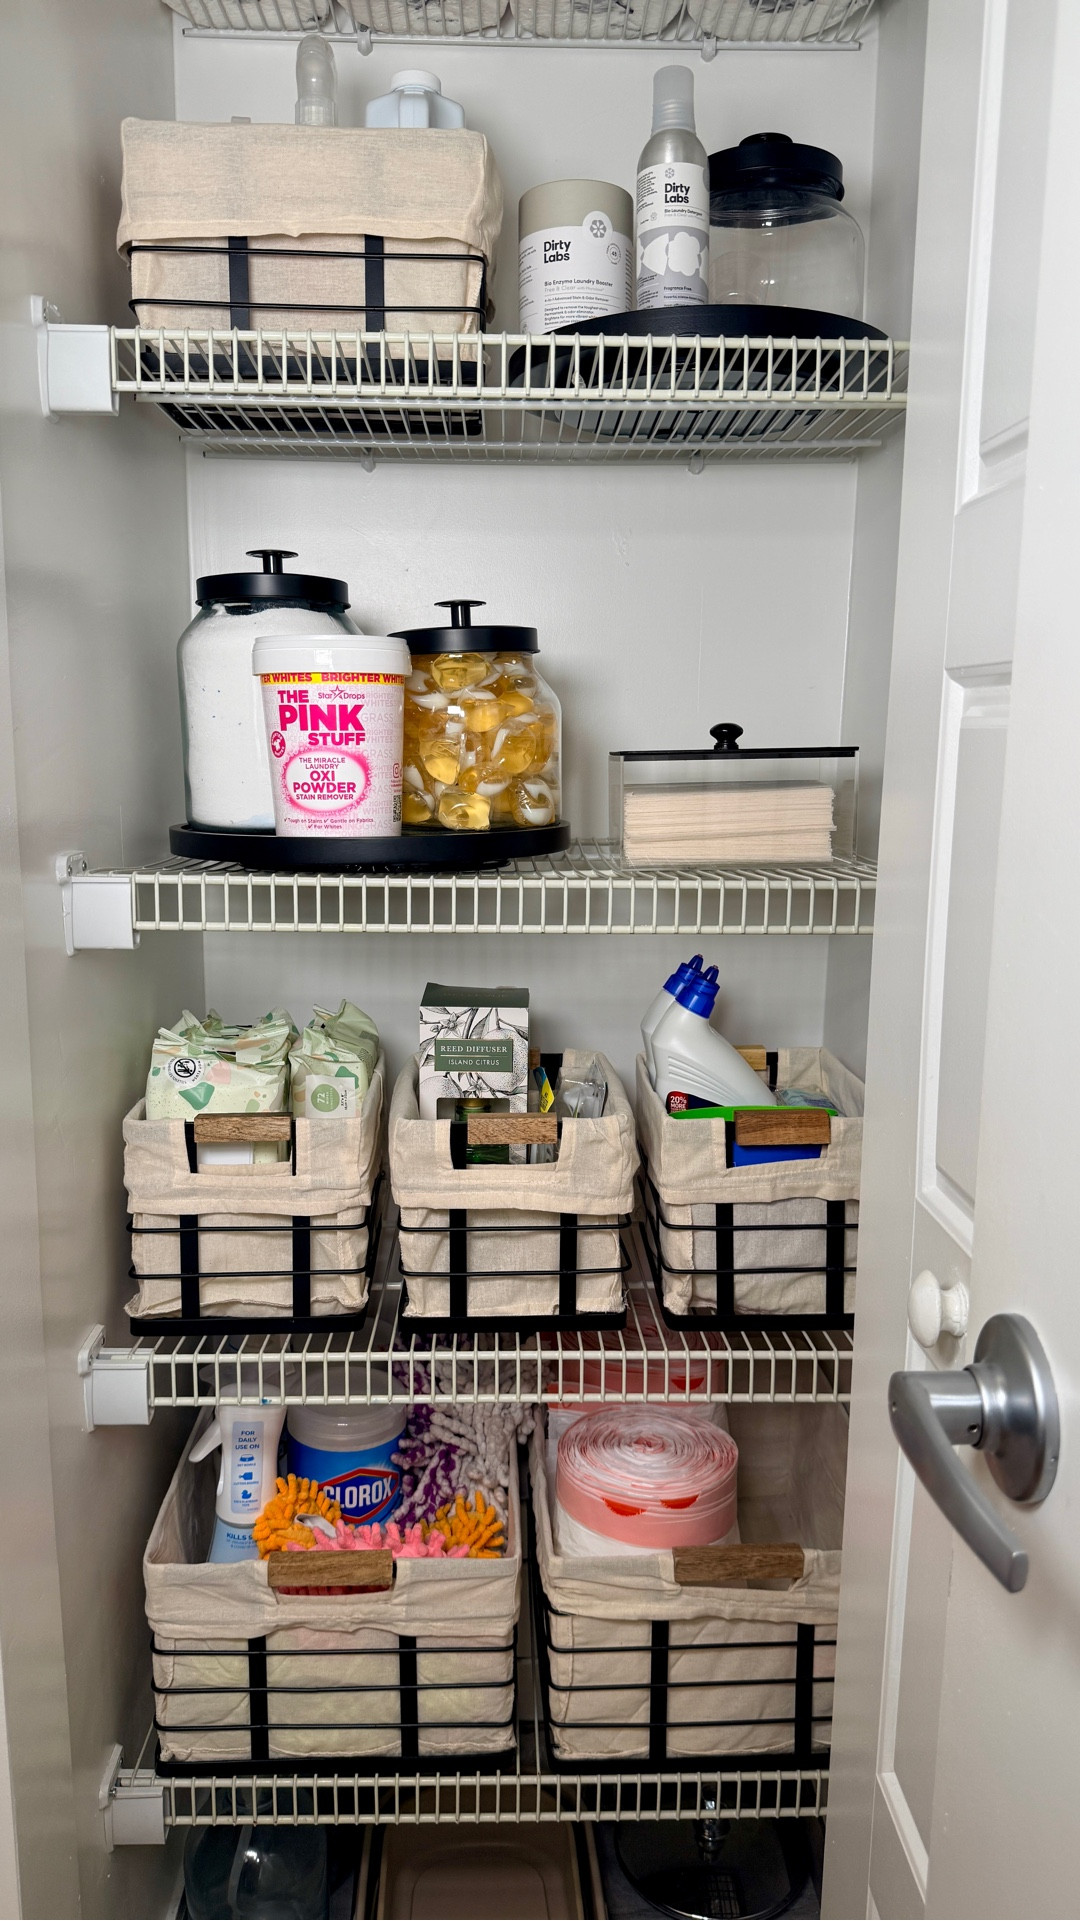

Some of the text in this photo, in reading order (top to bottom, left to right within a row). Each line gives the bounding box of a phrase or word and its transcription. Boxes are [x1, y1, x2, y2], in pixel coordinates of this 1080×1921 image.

[664, 182, 690, 195] Dirty
[664, 193, 689, 203] Labs
[544, 240, 571, 252] Dirty
[544, 252, 570, 264] Labs
[272, 673, 312, 682] WHITES
[321, 672, 380, 682] BRIGHTER
[278, 690, 309, 703] THE
[344, 692, 365, 700] Drops
[279, 704, 365, 731] PINK
[308, 733, 365, 745] STUFF
[310, 770, 335, 781] OXI
[293, 782, 356, 793] POWDER
[317, 1092, 325, 1103] 72
[323, 1475, 392, 1508] CLOROX
